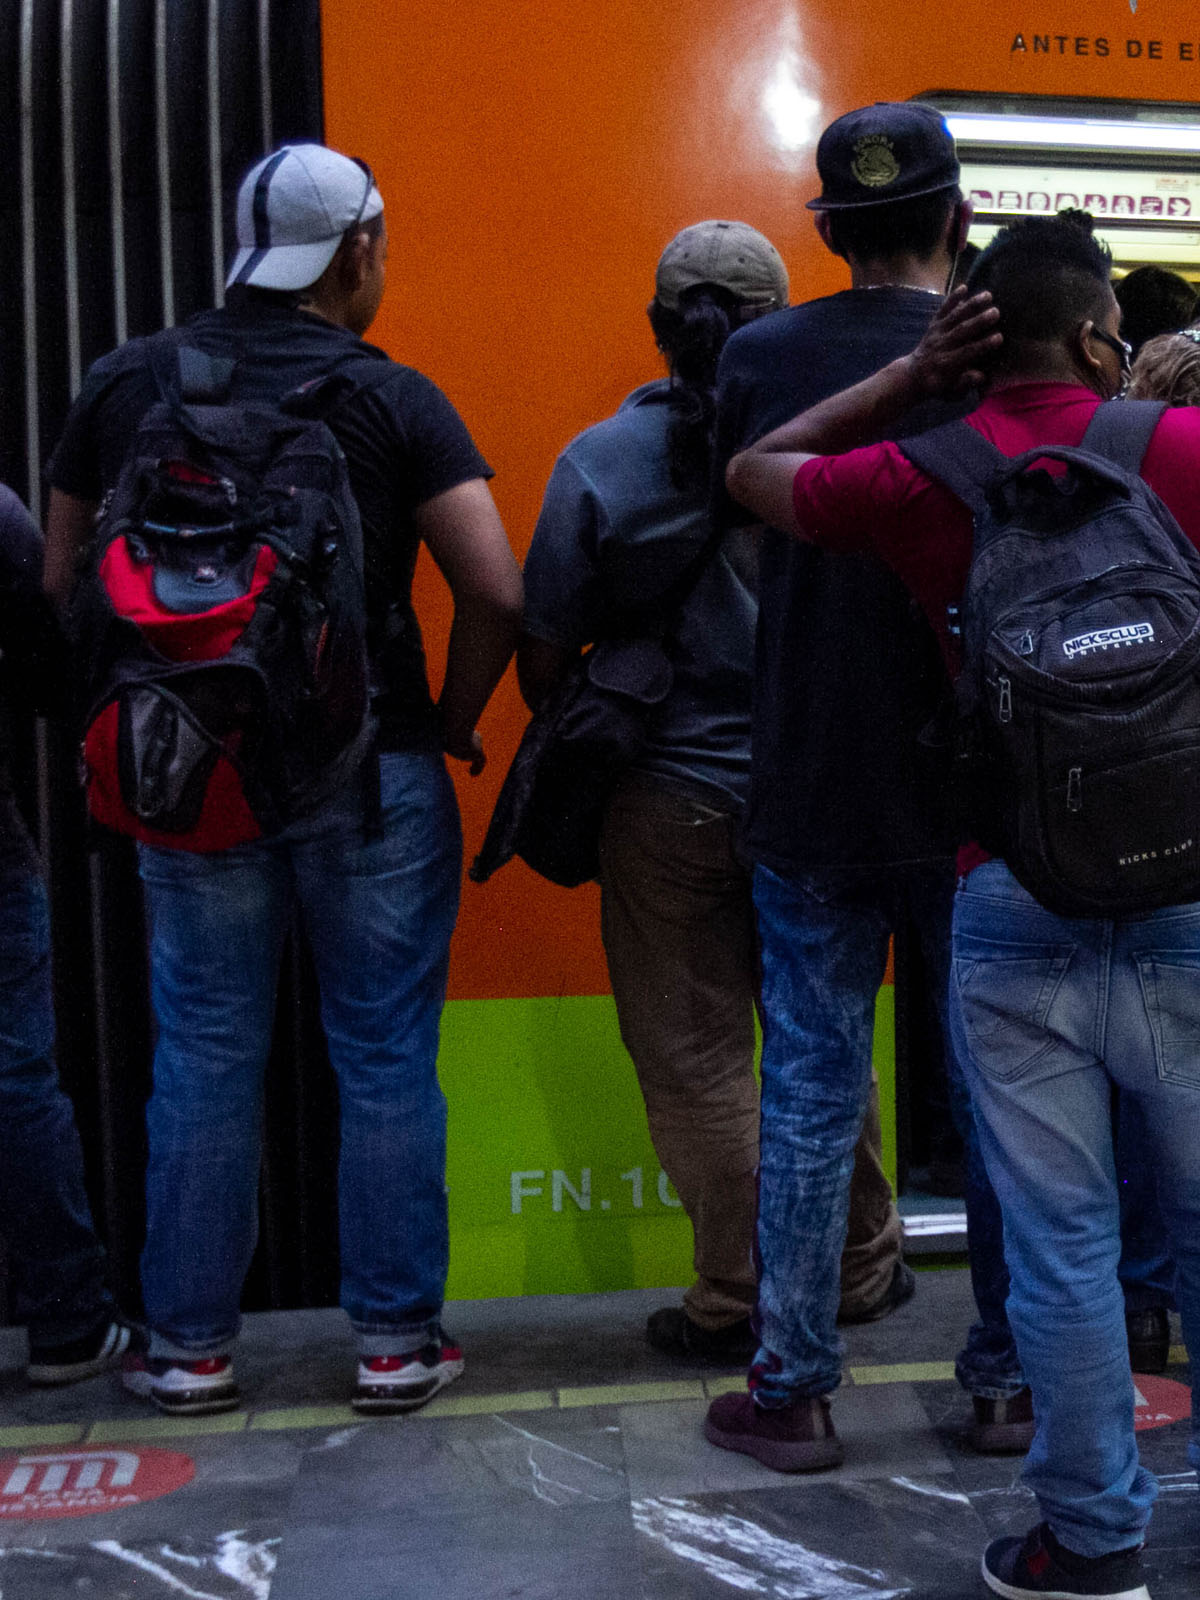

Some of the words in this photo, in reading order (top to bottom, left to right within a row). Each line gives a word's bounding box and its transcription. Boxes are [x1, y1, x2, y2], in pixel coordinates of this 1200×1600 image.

[1011, 34, 1110, 57] ANTES
[1126, 40, 1163, 59] DE
[1064, 624, 1152, 654] NICKSCLUB
